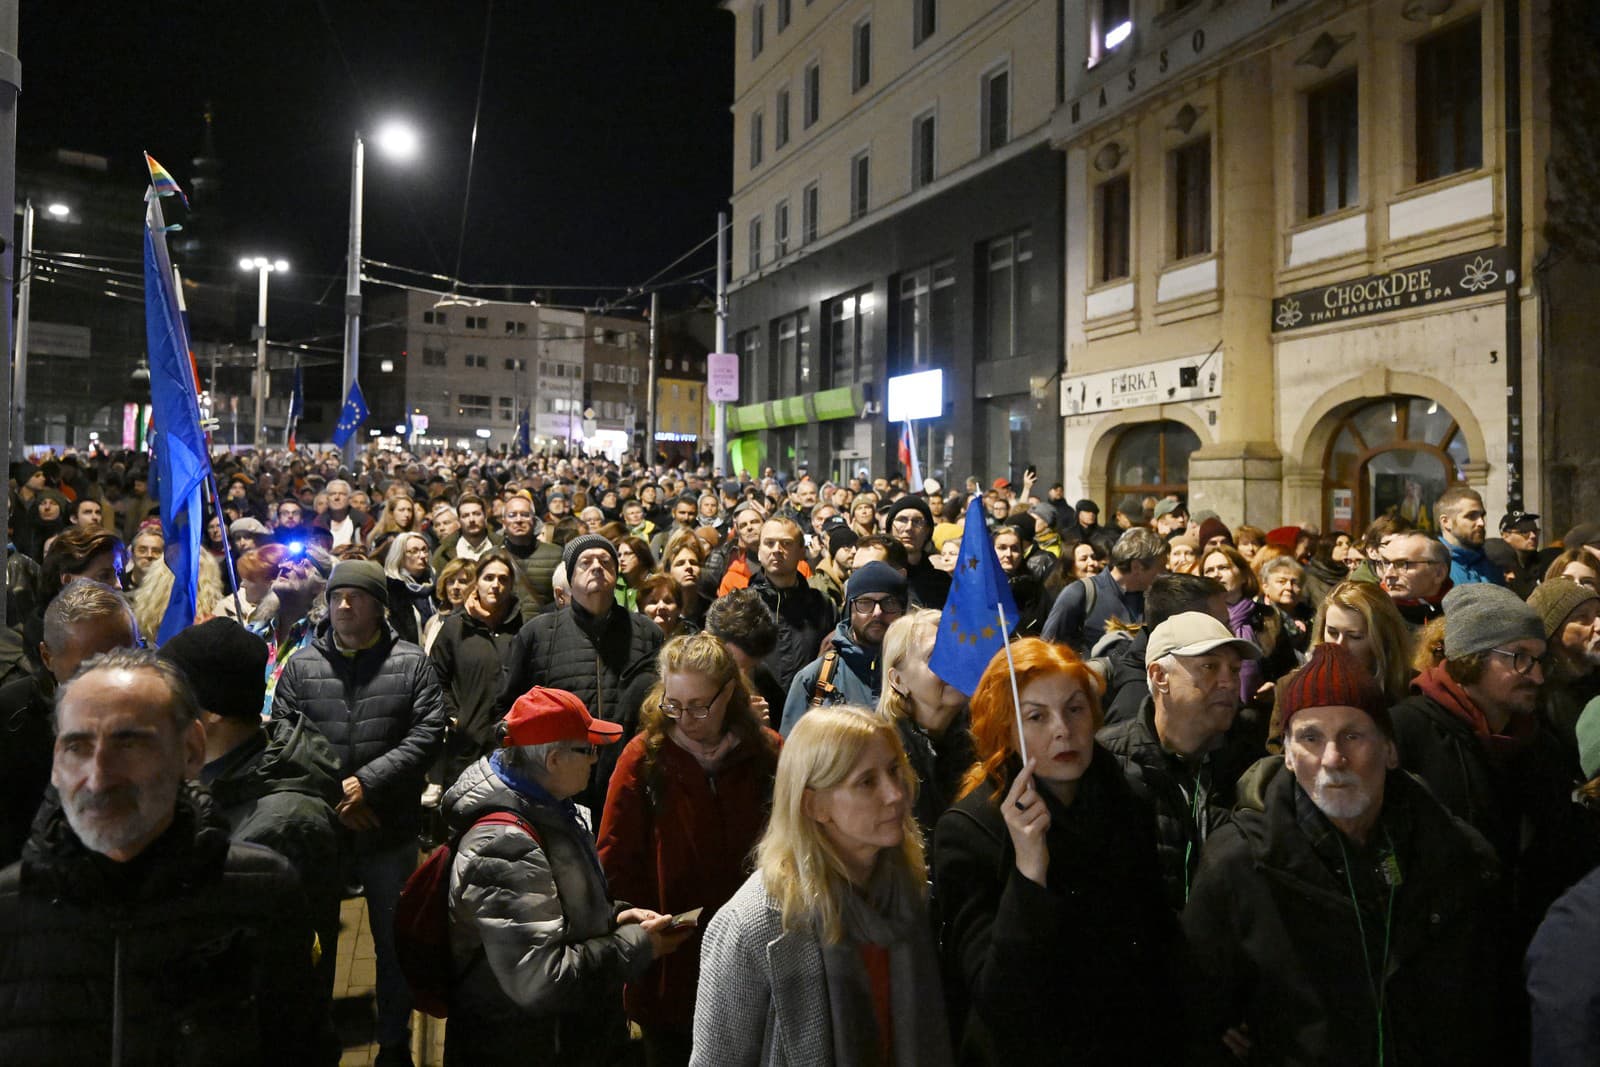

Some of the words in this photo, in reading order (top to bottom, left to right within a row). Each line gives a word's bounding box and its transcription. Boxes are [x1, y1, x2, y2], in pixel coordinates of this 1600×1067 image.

[1310, 310, 1337, 322] THAI
[1341, 298, 1401, 315] MASSAGE
[1409, 293, 1418, 304] &
[1425, 286, 1453, 301] SPA
